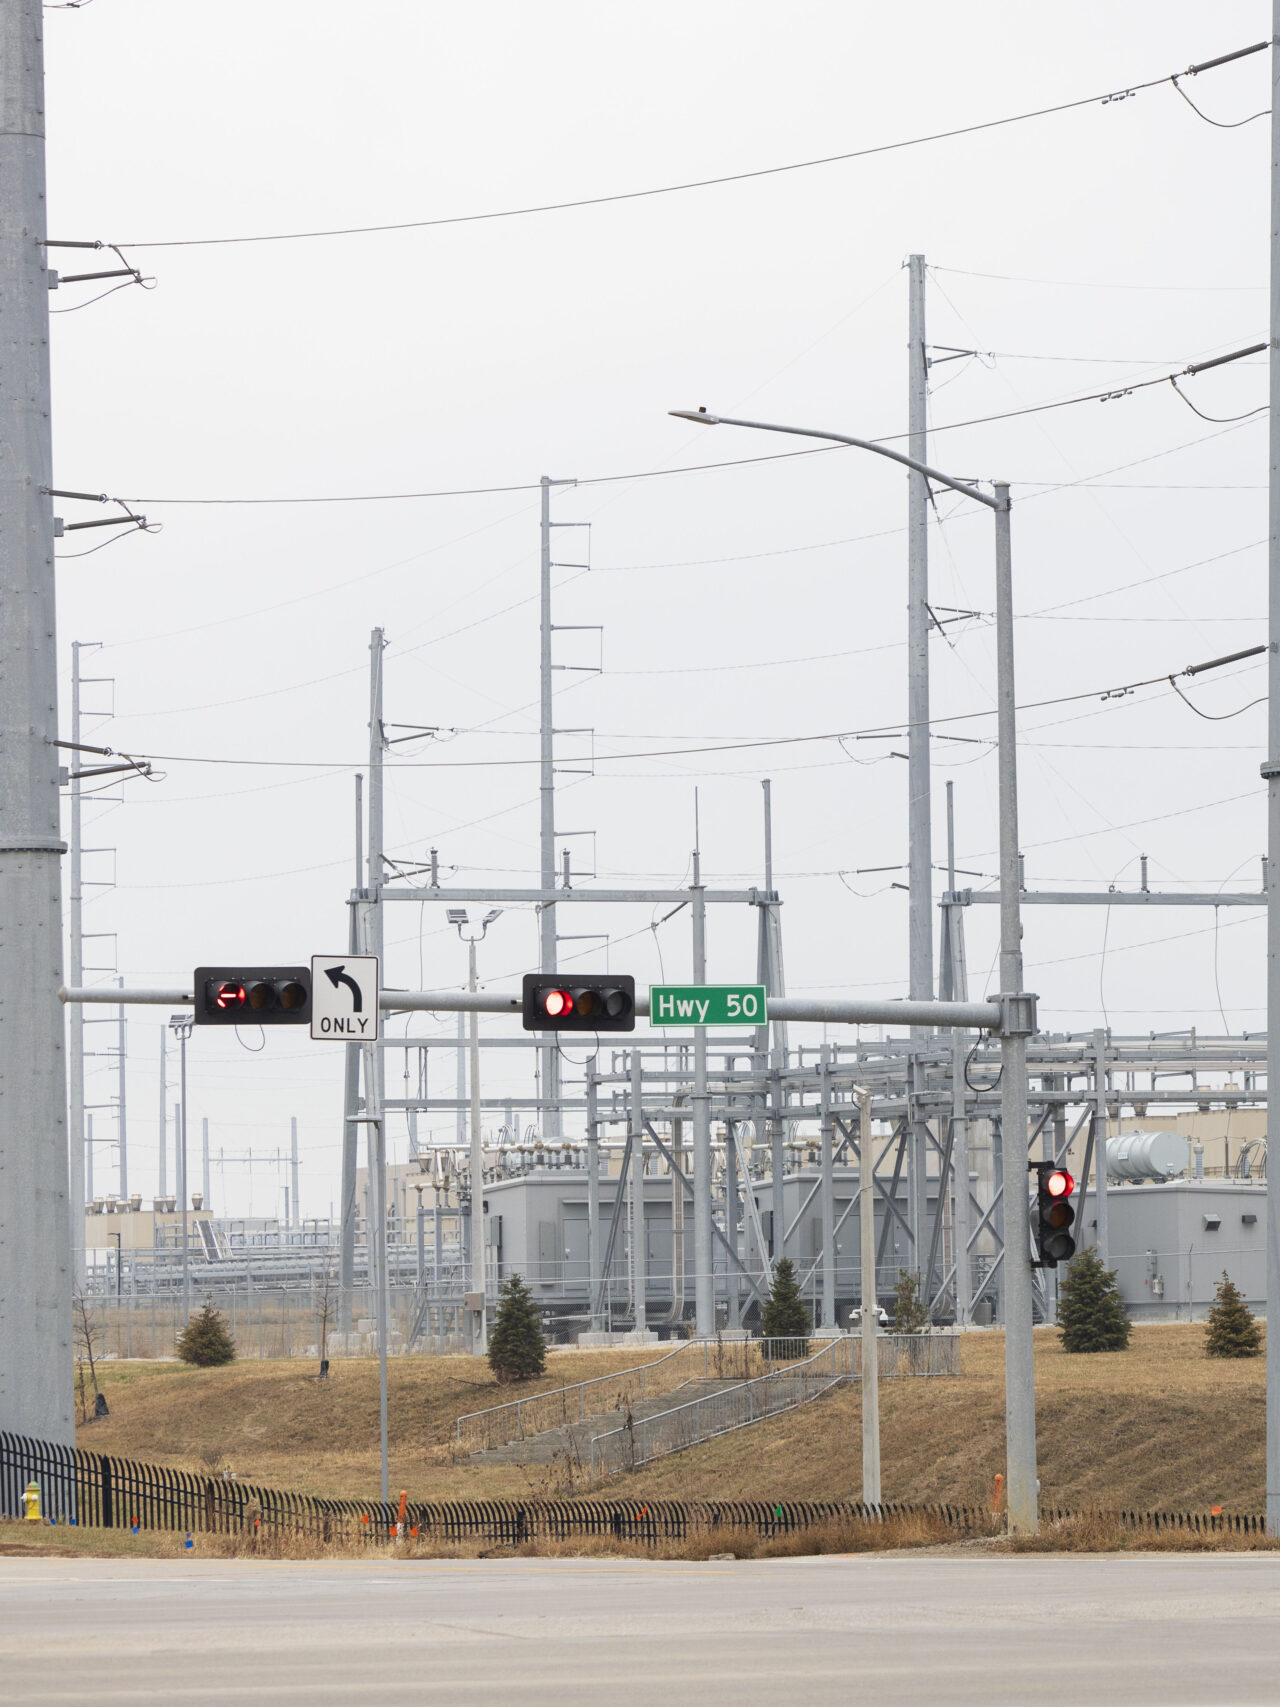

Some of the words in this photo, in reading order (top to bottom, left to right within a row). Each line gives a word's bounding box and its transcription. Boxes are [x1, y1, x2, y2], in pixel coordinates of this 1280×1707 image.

[659, 994, 710, 1023] Hwy
[727, 993, 758, 1017] 50
[320, 1016, 369, 1034] ONLY
